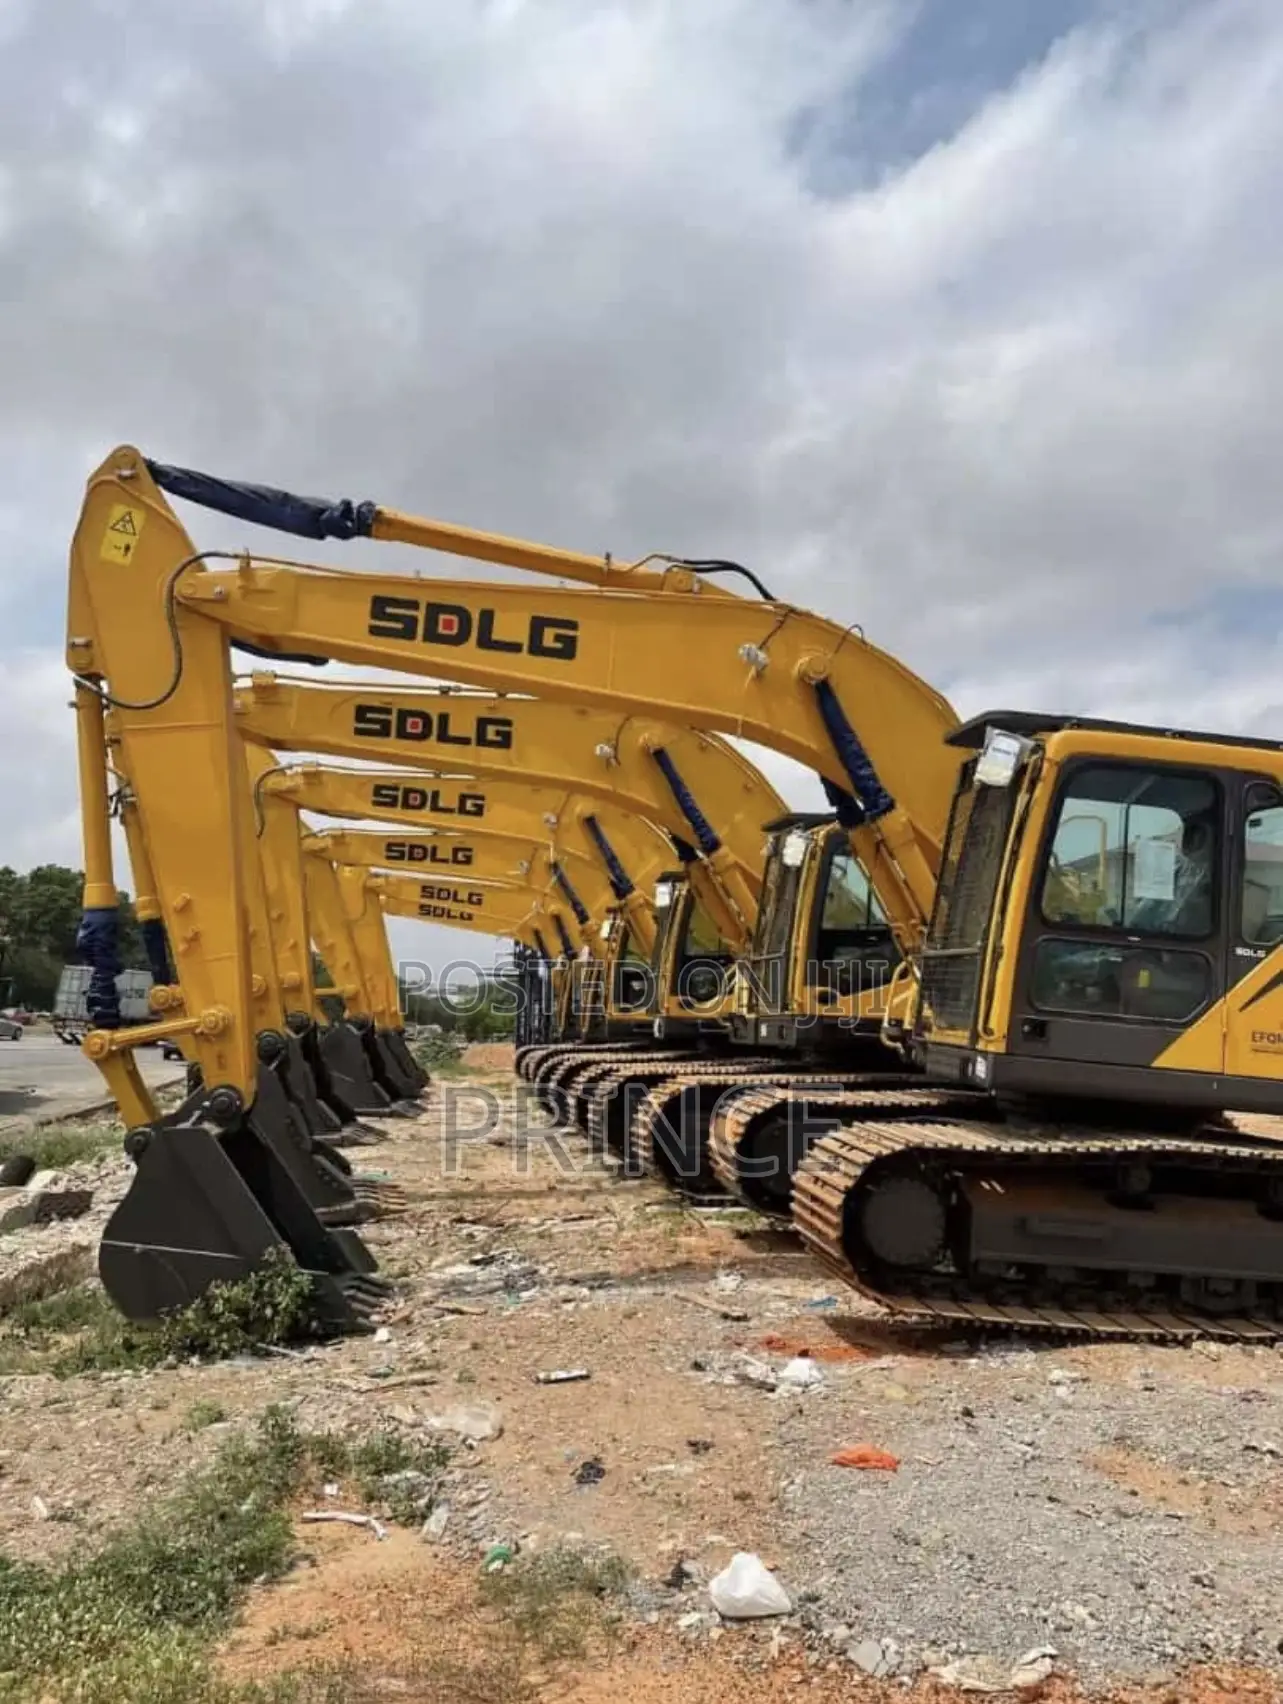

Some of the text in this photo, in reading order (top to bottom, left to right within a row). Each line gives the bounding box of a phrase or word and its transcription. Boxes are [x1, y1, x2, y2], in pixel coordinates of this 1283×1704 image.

[368, 594, 579, 661] SDLG
[354, 704, 513, 749] SDLG
[371, 784, 486, 817] SDLG
[385, 841, 474, 865] SDLG
[421, 885, 483, 905] SDLG
[418, 904, 473, 921] SDLG
